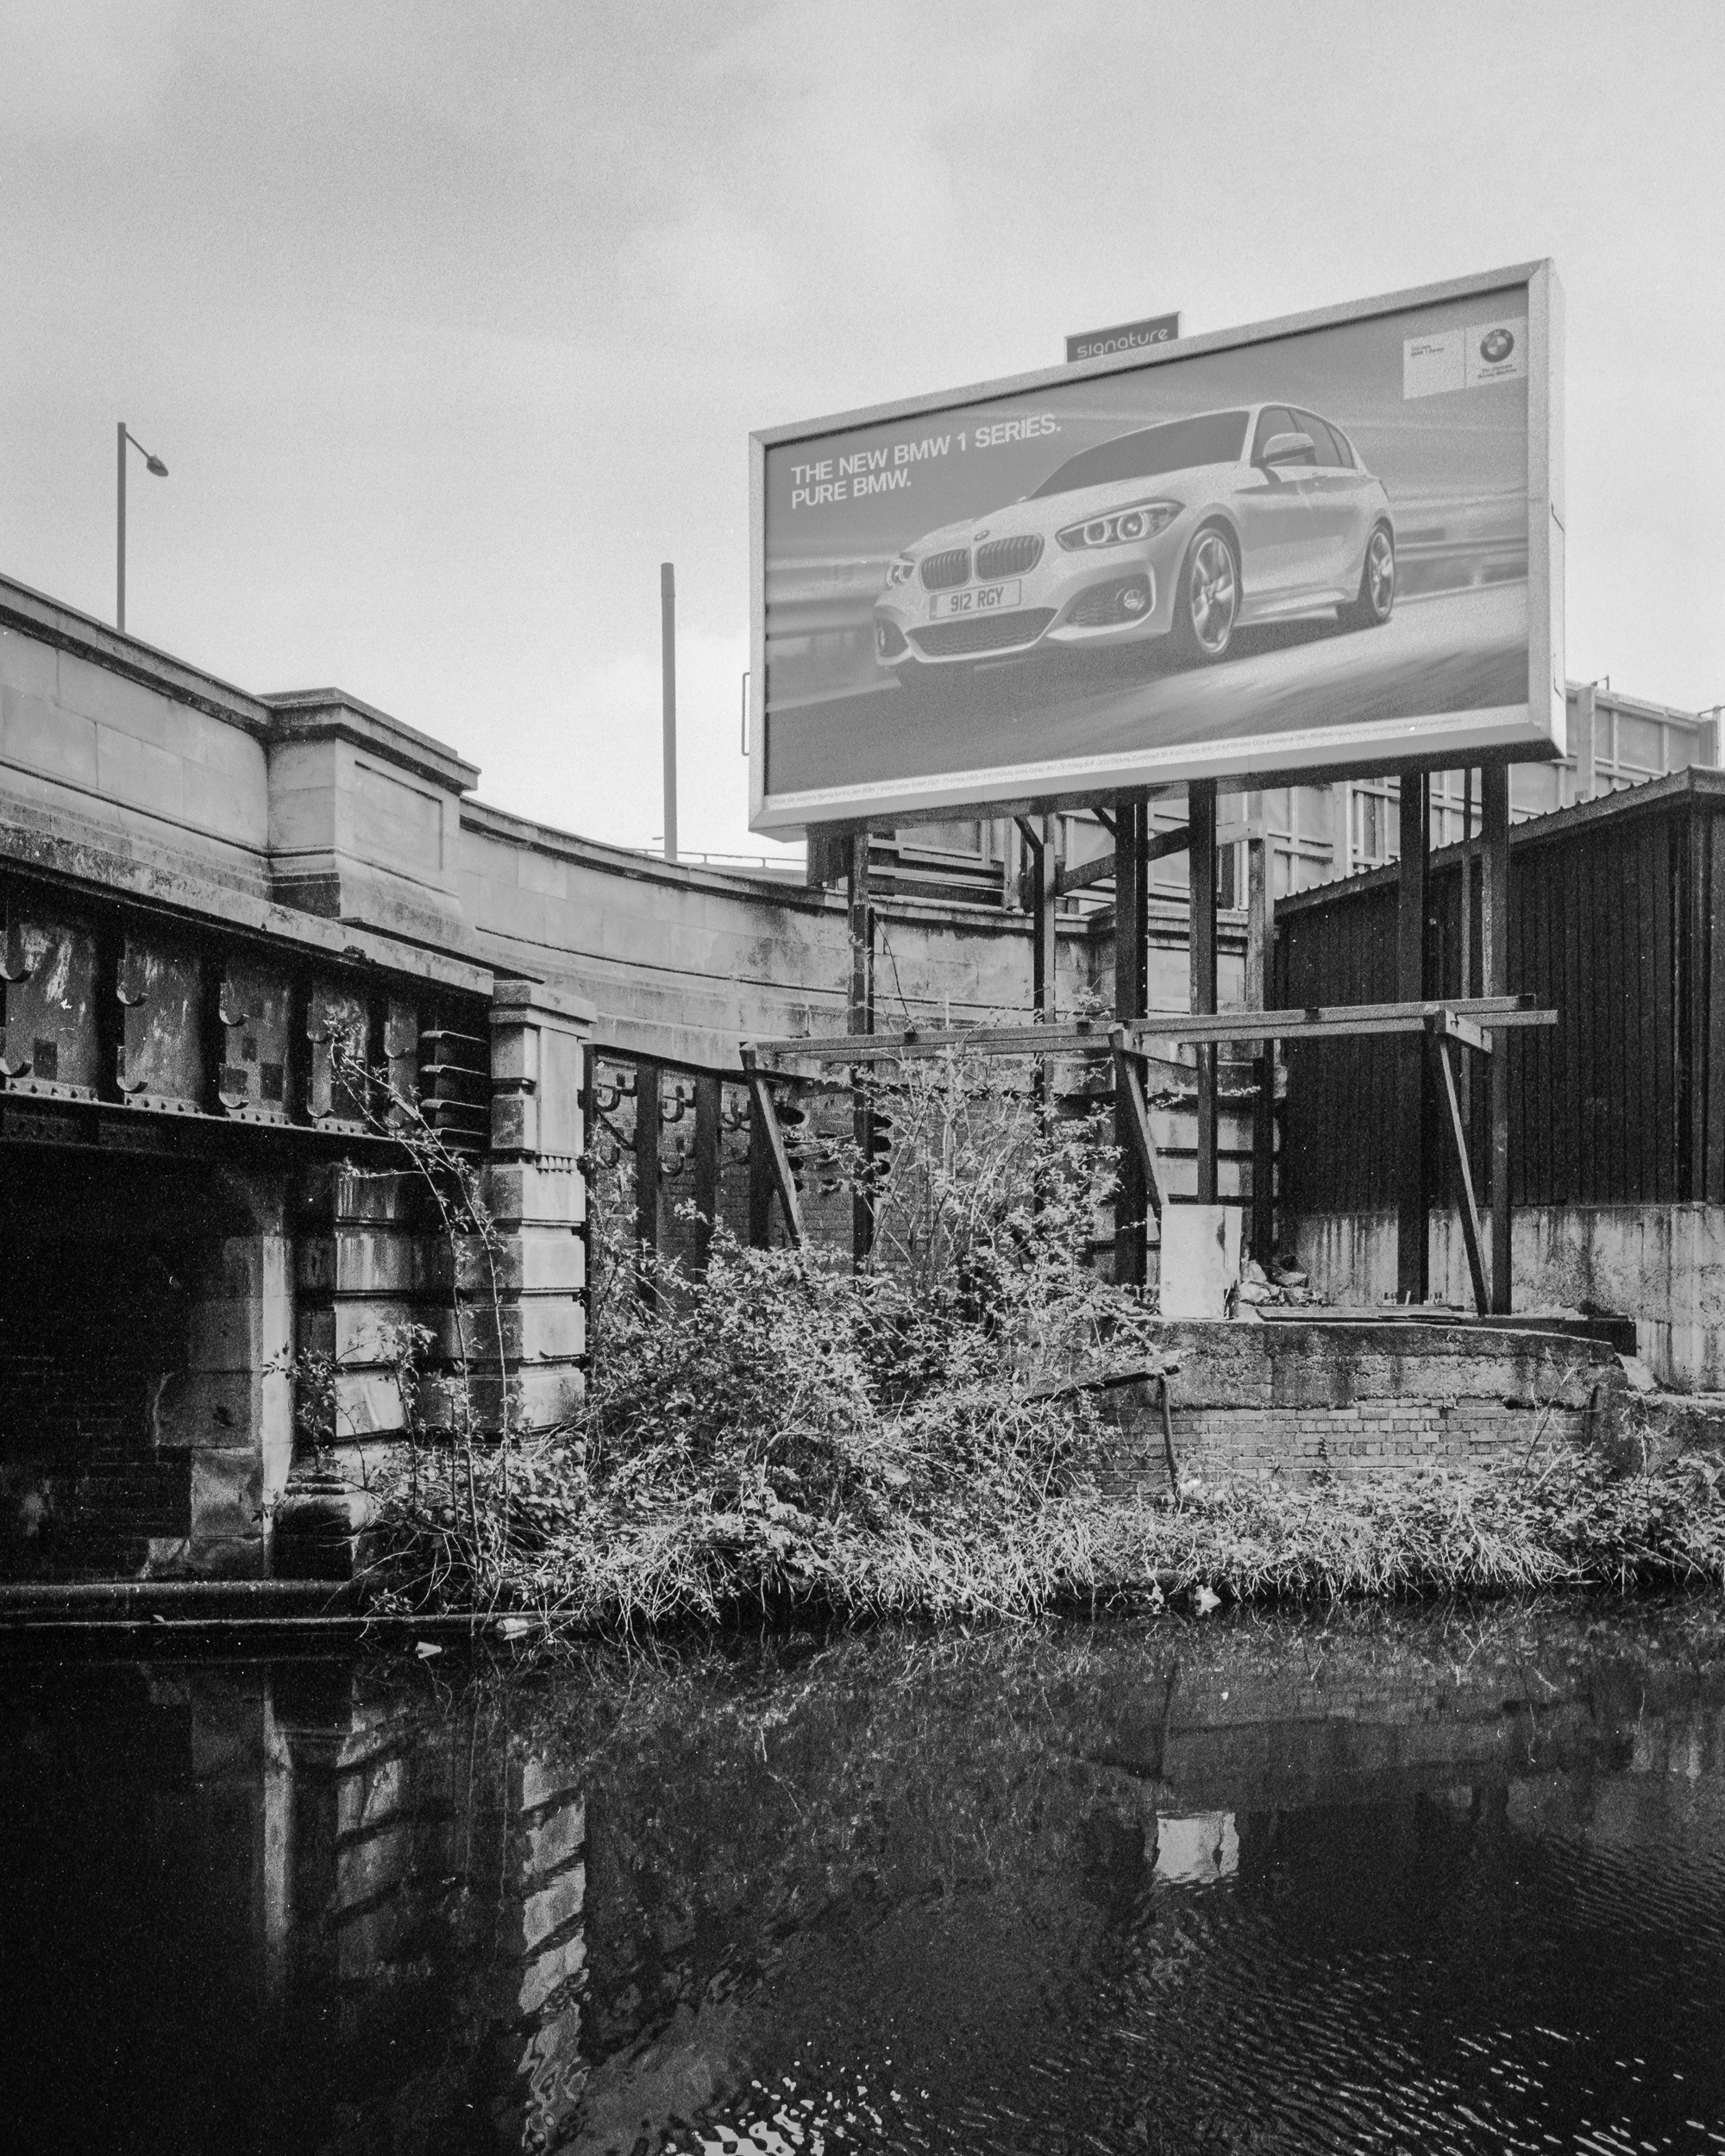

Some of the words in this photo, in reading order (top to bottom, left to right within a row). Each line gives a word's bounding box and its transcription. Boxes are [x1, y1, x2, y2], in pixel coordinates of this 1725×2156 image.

[1076, 329, 1169, 359] signature
[791, 459, 833, 485] THE
[838, 448, 888, 476] NEW
[894, 435, 950, 465] BMW
[957, 432, 967, 451] 1
[974, 413, 1063, 448] SERIES.
[791, 480, 847, 509] PURE
[853, 468, 912, 497] BMW.
[950, 592, 972, 612] 912
[977, 586, 1004, 608] RGY
